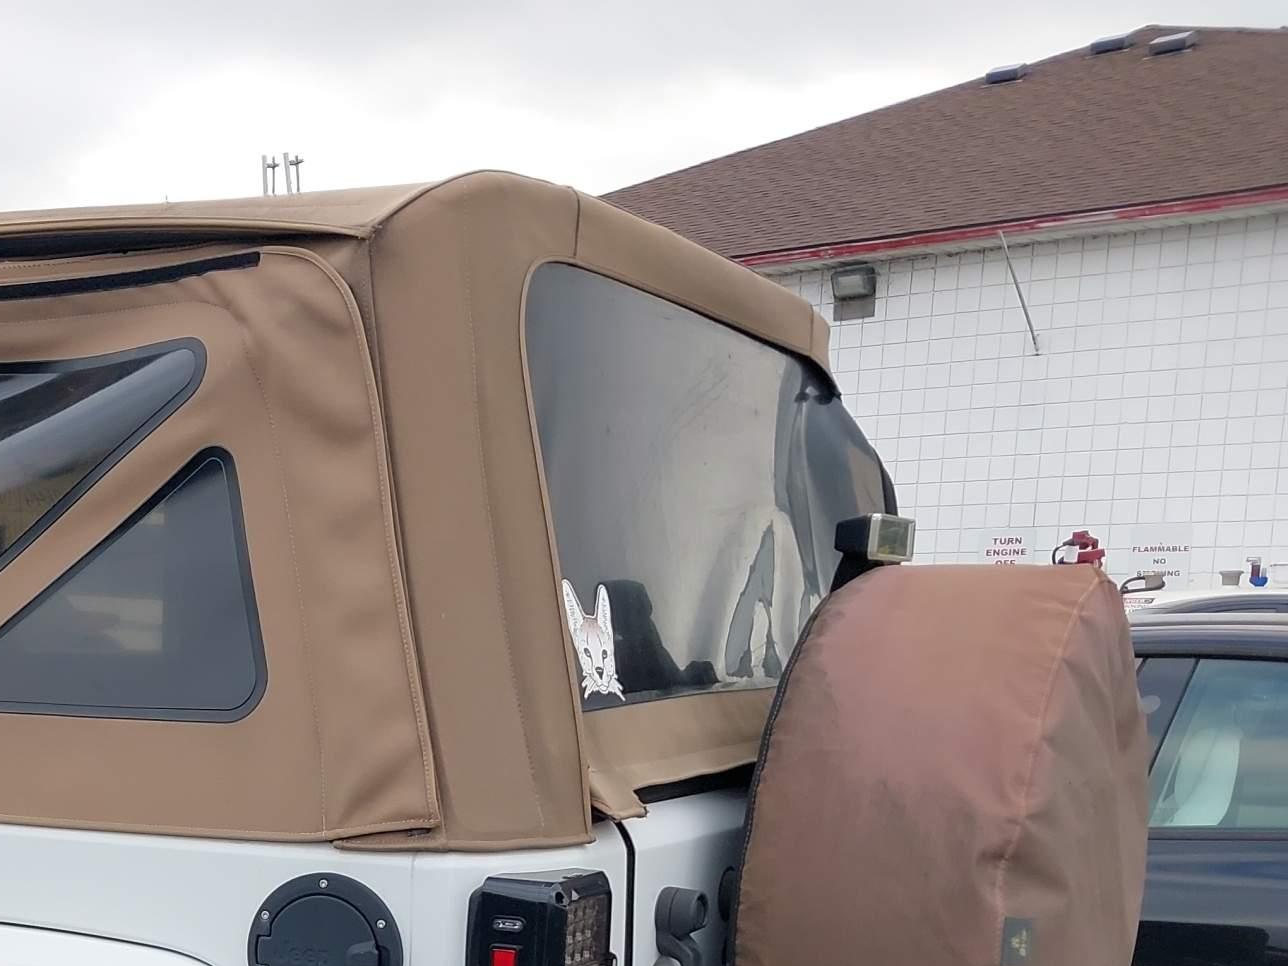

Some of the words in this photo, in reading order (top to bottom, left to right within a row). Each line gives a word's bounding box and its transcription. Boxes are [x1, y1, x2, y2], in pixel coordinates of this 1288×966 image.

[992, 537, 1022, 546] TURN
[985, 548, 1027, 556] ENGINE
[1132, 545, 1189, 553] FLAMMABLE
